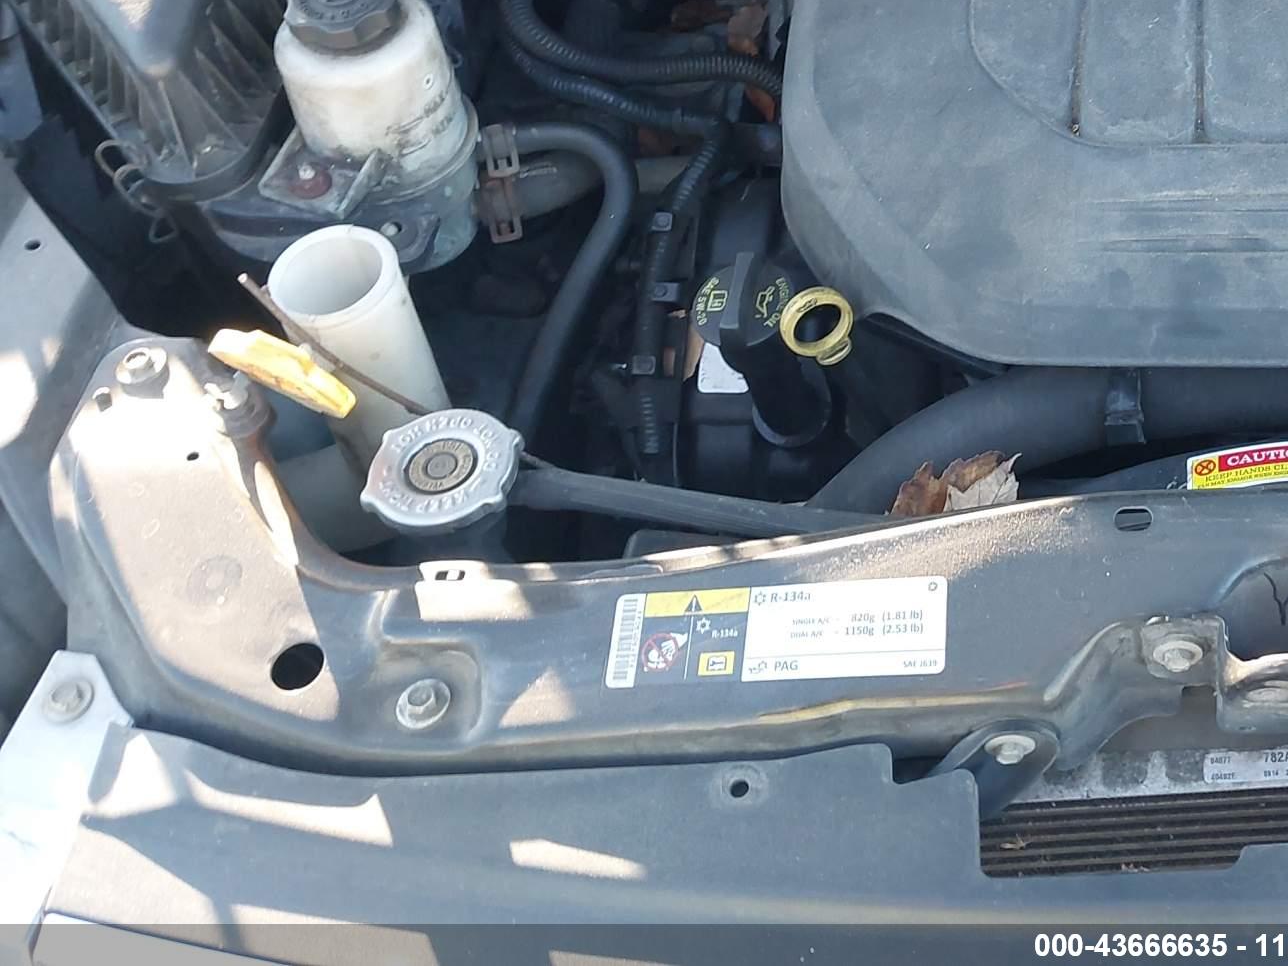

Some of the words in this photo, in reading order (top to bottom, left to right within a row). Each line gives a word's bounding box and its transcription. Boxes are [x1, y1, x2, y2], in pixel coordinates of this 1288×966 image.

[701, 276, 720, 296] SAE
[696, 296, 708, 326] 5W-20
[763, 312, 781, 328] OIL
[1205, 471, 1233, 482] KEEP
[1234, 464, 1271, 477] HANDS
[770, 590, 811, 603] R-134a
[817, 616, 831, 625] A/C
[851, 612, 876, 624] 820g
[881, 610, 908, 622] (1.81
[909, 609, 924, 621] lb)
[711, 628, 738, 639] R-134a
[810, 630, 823, 638] A/C
[844, 625, 875, 636] 1150g
[881, 624, 908, 636] (2.53
[910, 623, 924, 634] lb)
[774, 660, 799, 672] PAG
